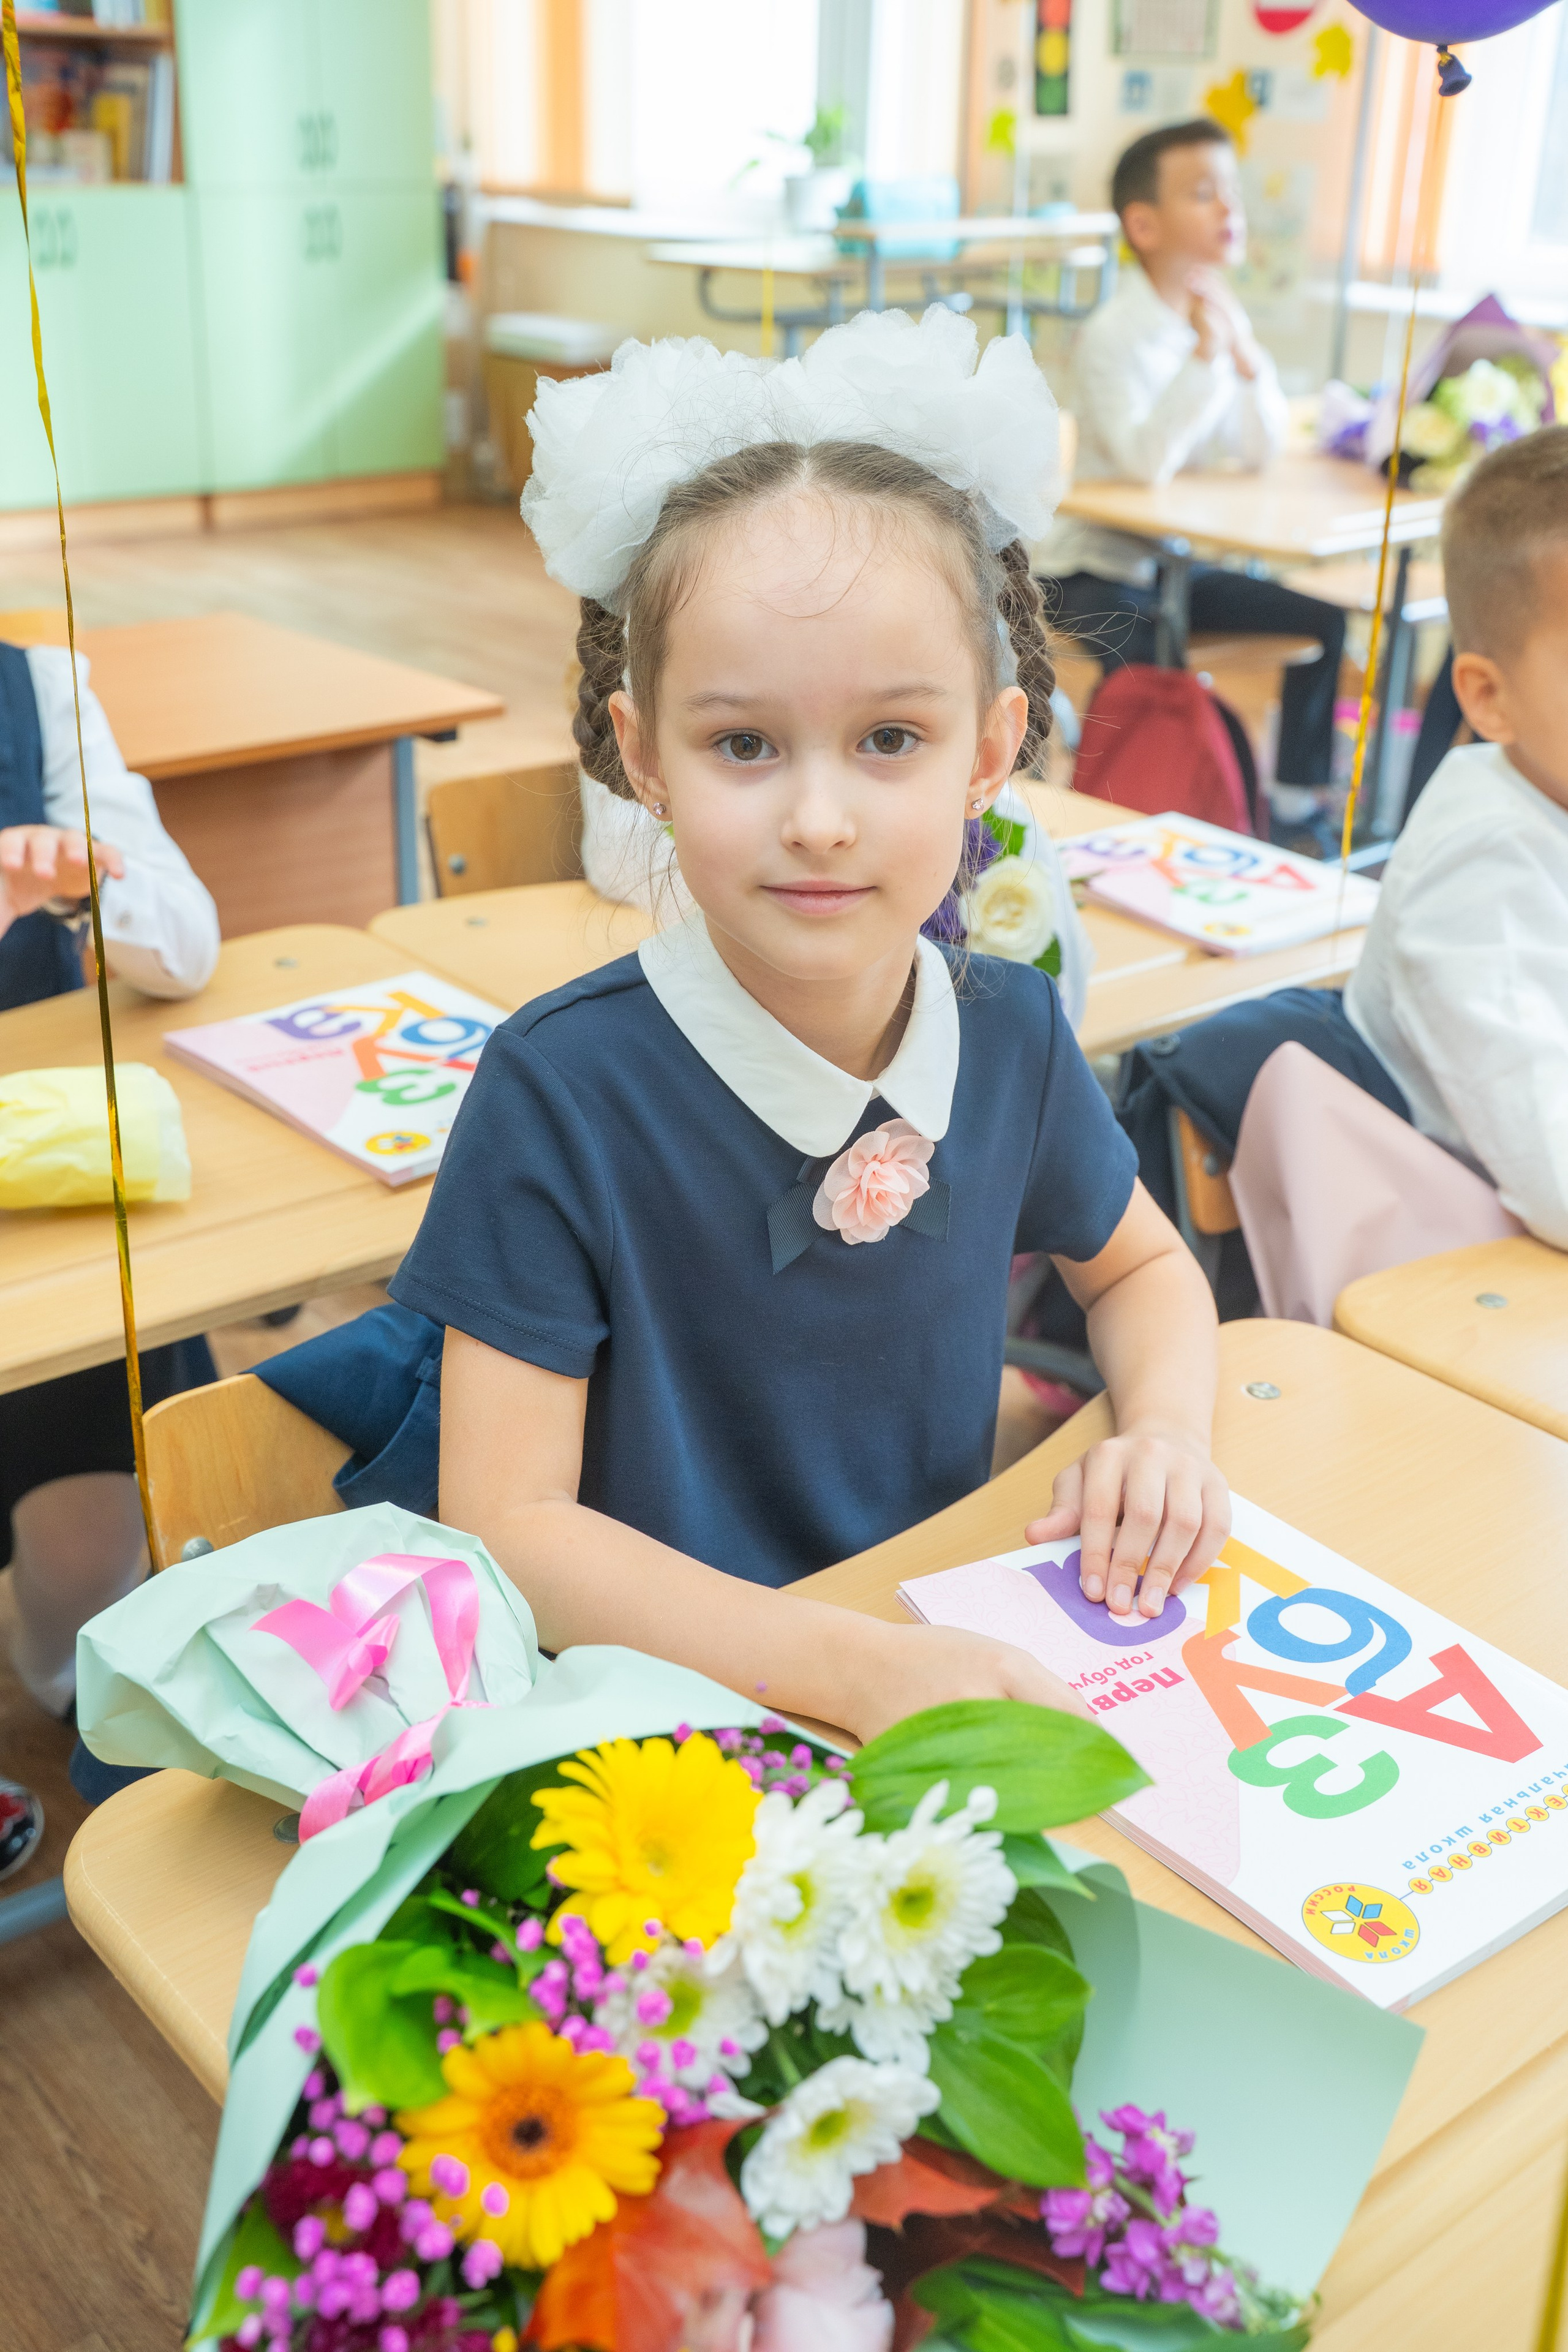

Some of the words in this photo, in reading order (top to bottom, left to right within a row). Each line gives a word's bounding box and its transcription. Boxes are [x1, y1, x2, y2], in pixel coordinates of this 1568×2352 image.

[264, 990, 494, 1106] збука
[1114, 1651, 1155, 1670] год
[1067, 1667, 1117, 1690] обуч
[1401, 1825, 1474, 1870] школа
[1412, 1785, 1568, 1892] ЕКТИВНАЯ
[1305, 1885, 1356, 1915] РОССИИ
[1364, 1928, 1415, 1959] ШКОЛА
